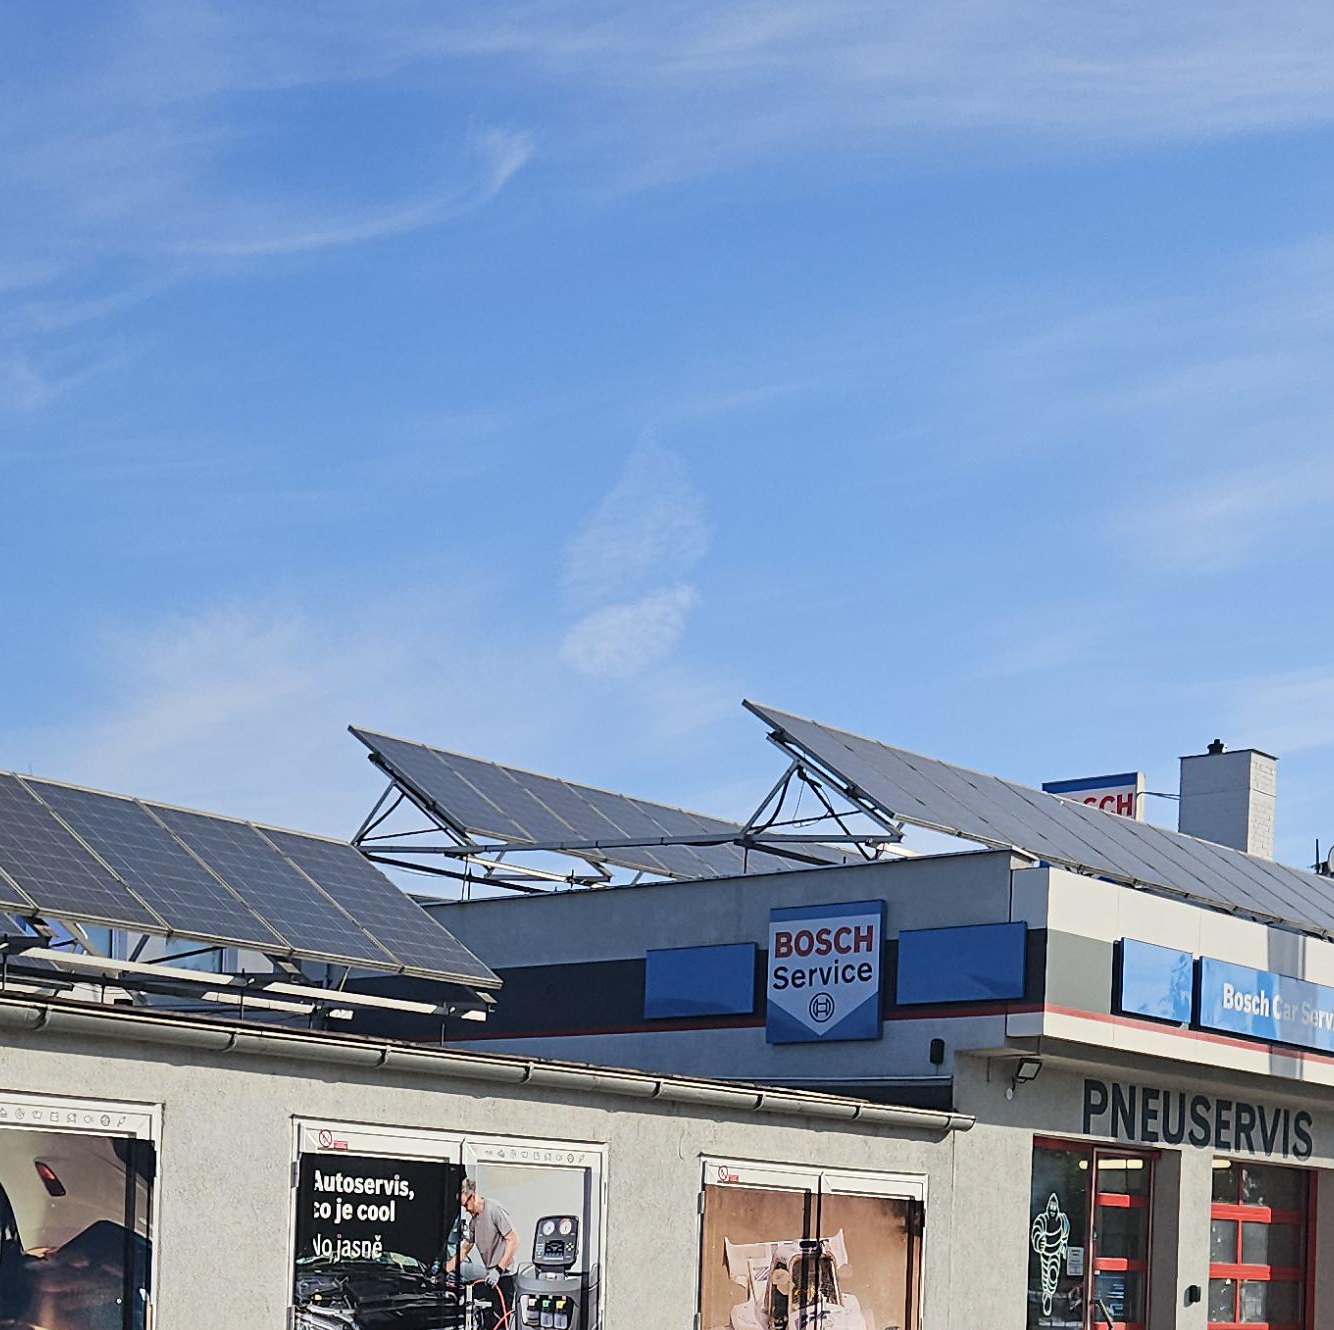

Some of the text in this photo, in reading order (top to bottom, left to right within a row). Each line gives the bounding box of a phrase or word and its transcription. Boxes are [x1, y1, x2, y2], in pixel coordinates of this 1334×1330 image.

[775, 925, 873, 958] BOSCH
[772, 959, 873, 990] Service
[1223, 983, 1269, 1017] Bosch
[1272, 994, 1298, 1021] Car
[1082, 1078, 1313, 1161] PNEUSERVIS
[314, 1170, 415, 1200] Autoservis,
[314, 1197, 396, 1224] co je cool
[313, 1233, 383, 1263] No jasně
